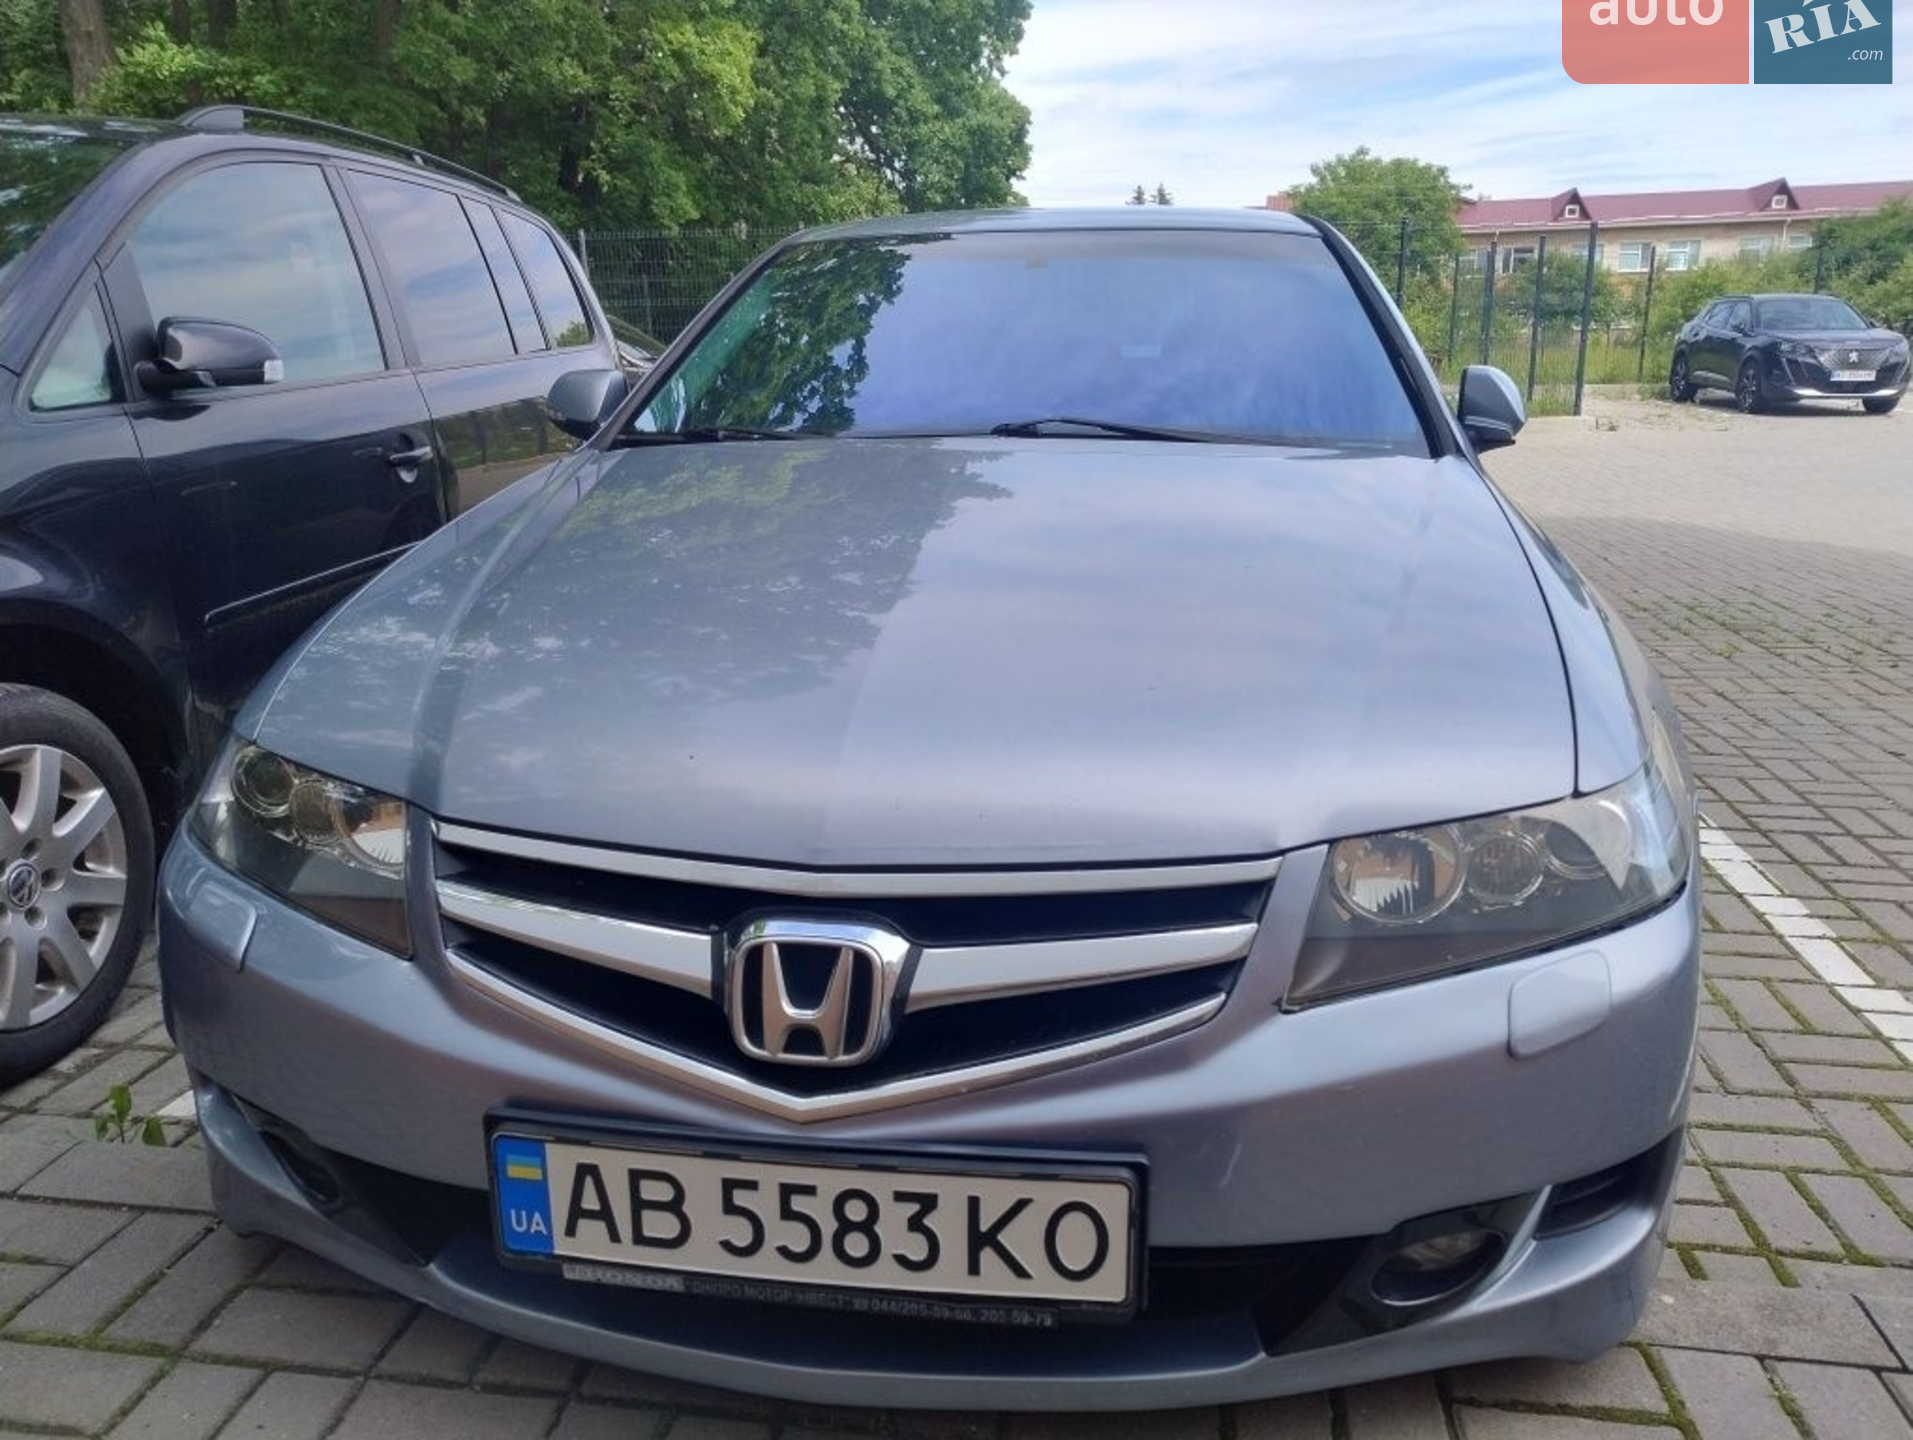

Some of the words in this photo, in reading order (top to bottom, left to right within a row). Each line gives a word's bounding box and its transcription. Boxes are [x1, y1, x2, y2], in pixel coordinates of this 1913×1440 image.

[510, 1208, 548, 1235] UA
[564, 1162, 693, 1250] AB
[718, 1177, 941, 1273] 5583
[966, 1194, 1110, 1283] KO
